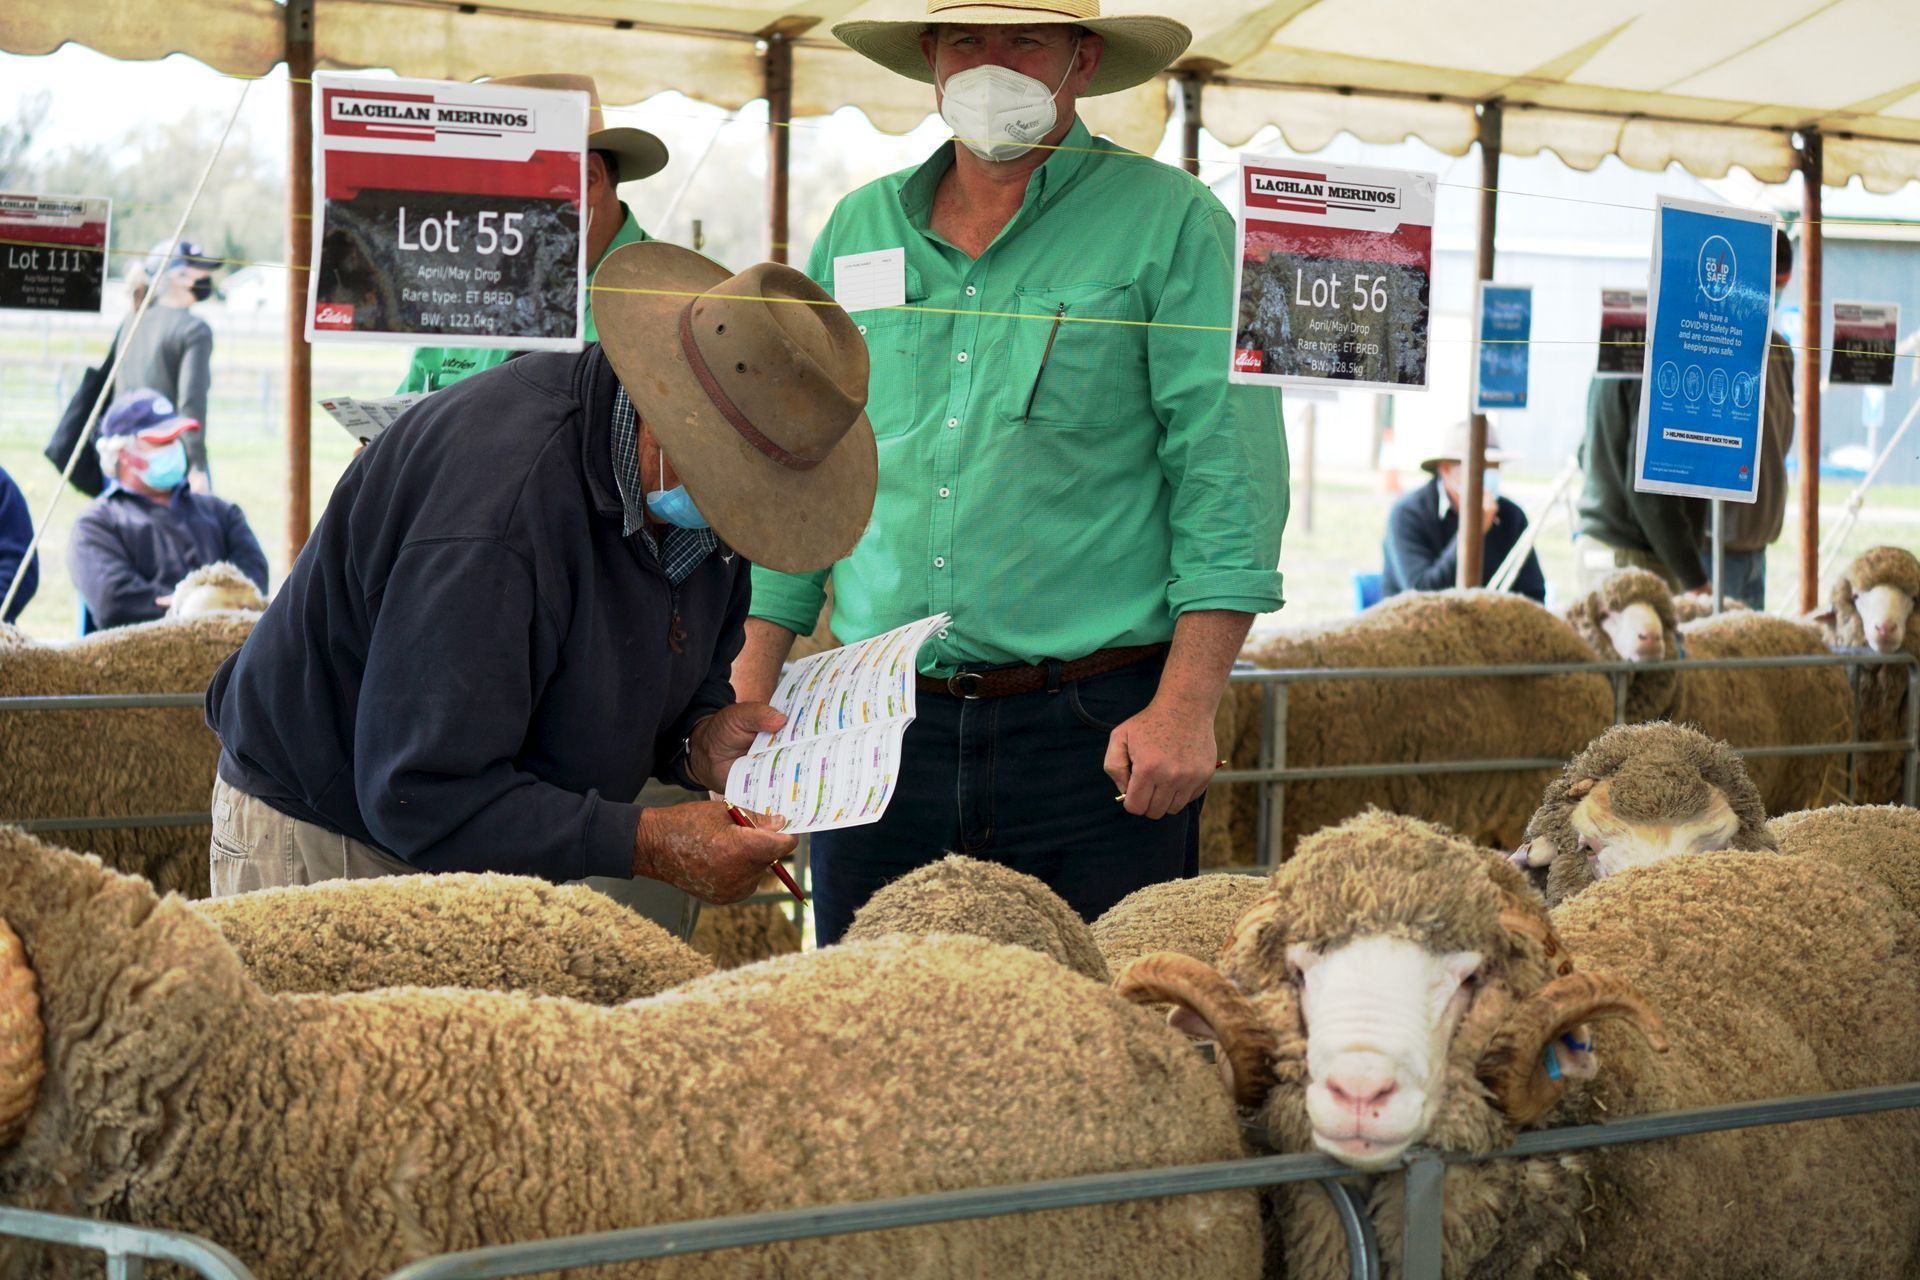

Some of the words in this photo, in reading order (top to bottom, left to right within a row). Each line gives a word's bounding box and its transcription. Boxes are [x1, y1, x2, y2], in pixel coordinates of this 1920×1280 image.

[338, 103, 430, 120] LACHLAN
[438, 110, 528, 127] MERINOS
[1256, 179, 1323, 195] LACHLAN
[1328, 187, 1395, 204] MERINOS
[398, 207, 460, 252] Lot
[476, 211, 524, 256] 55
[9, 248, 39, 269] Lot
[48, 250, 80, 272] 111
[417, 266, 471, 282] April/May
[475, 268, 501, 284] Drop
[1707, 272, 1727, 284] SAFE
[402, 288, 429, 302] Rare
[432, 290, 460, 305] type:
[466, 291, 480, 304] ET
[483, 292, 513, 305] BRED
[1296, 268, 1341, 309] Lot
[1352, 274, 1387, 313] 56
[421, 313, 444, 326] BW:
[1309, 319, 1348, 334] April/May
[1351, 323, 1370, 336] Drop
[1681, 320, 1709, 330] COVID-19
[1711, 324, 1729, 335] Safety
[1730, 326, 1742, 336] Plan
[1679, 331, 1690, 339] and
[1298, 339, 1317, 350] Rare
[1320, 341, 1340, 353] type:
[1344, 342, 1355, 352] ET
[1356, 343, 1378, 354] BRED
[1312, 360, 1328, 371] BW:
[1332, 362, 1364, 376] 128.5kg
